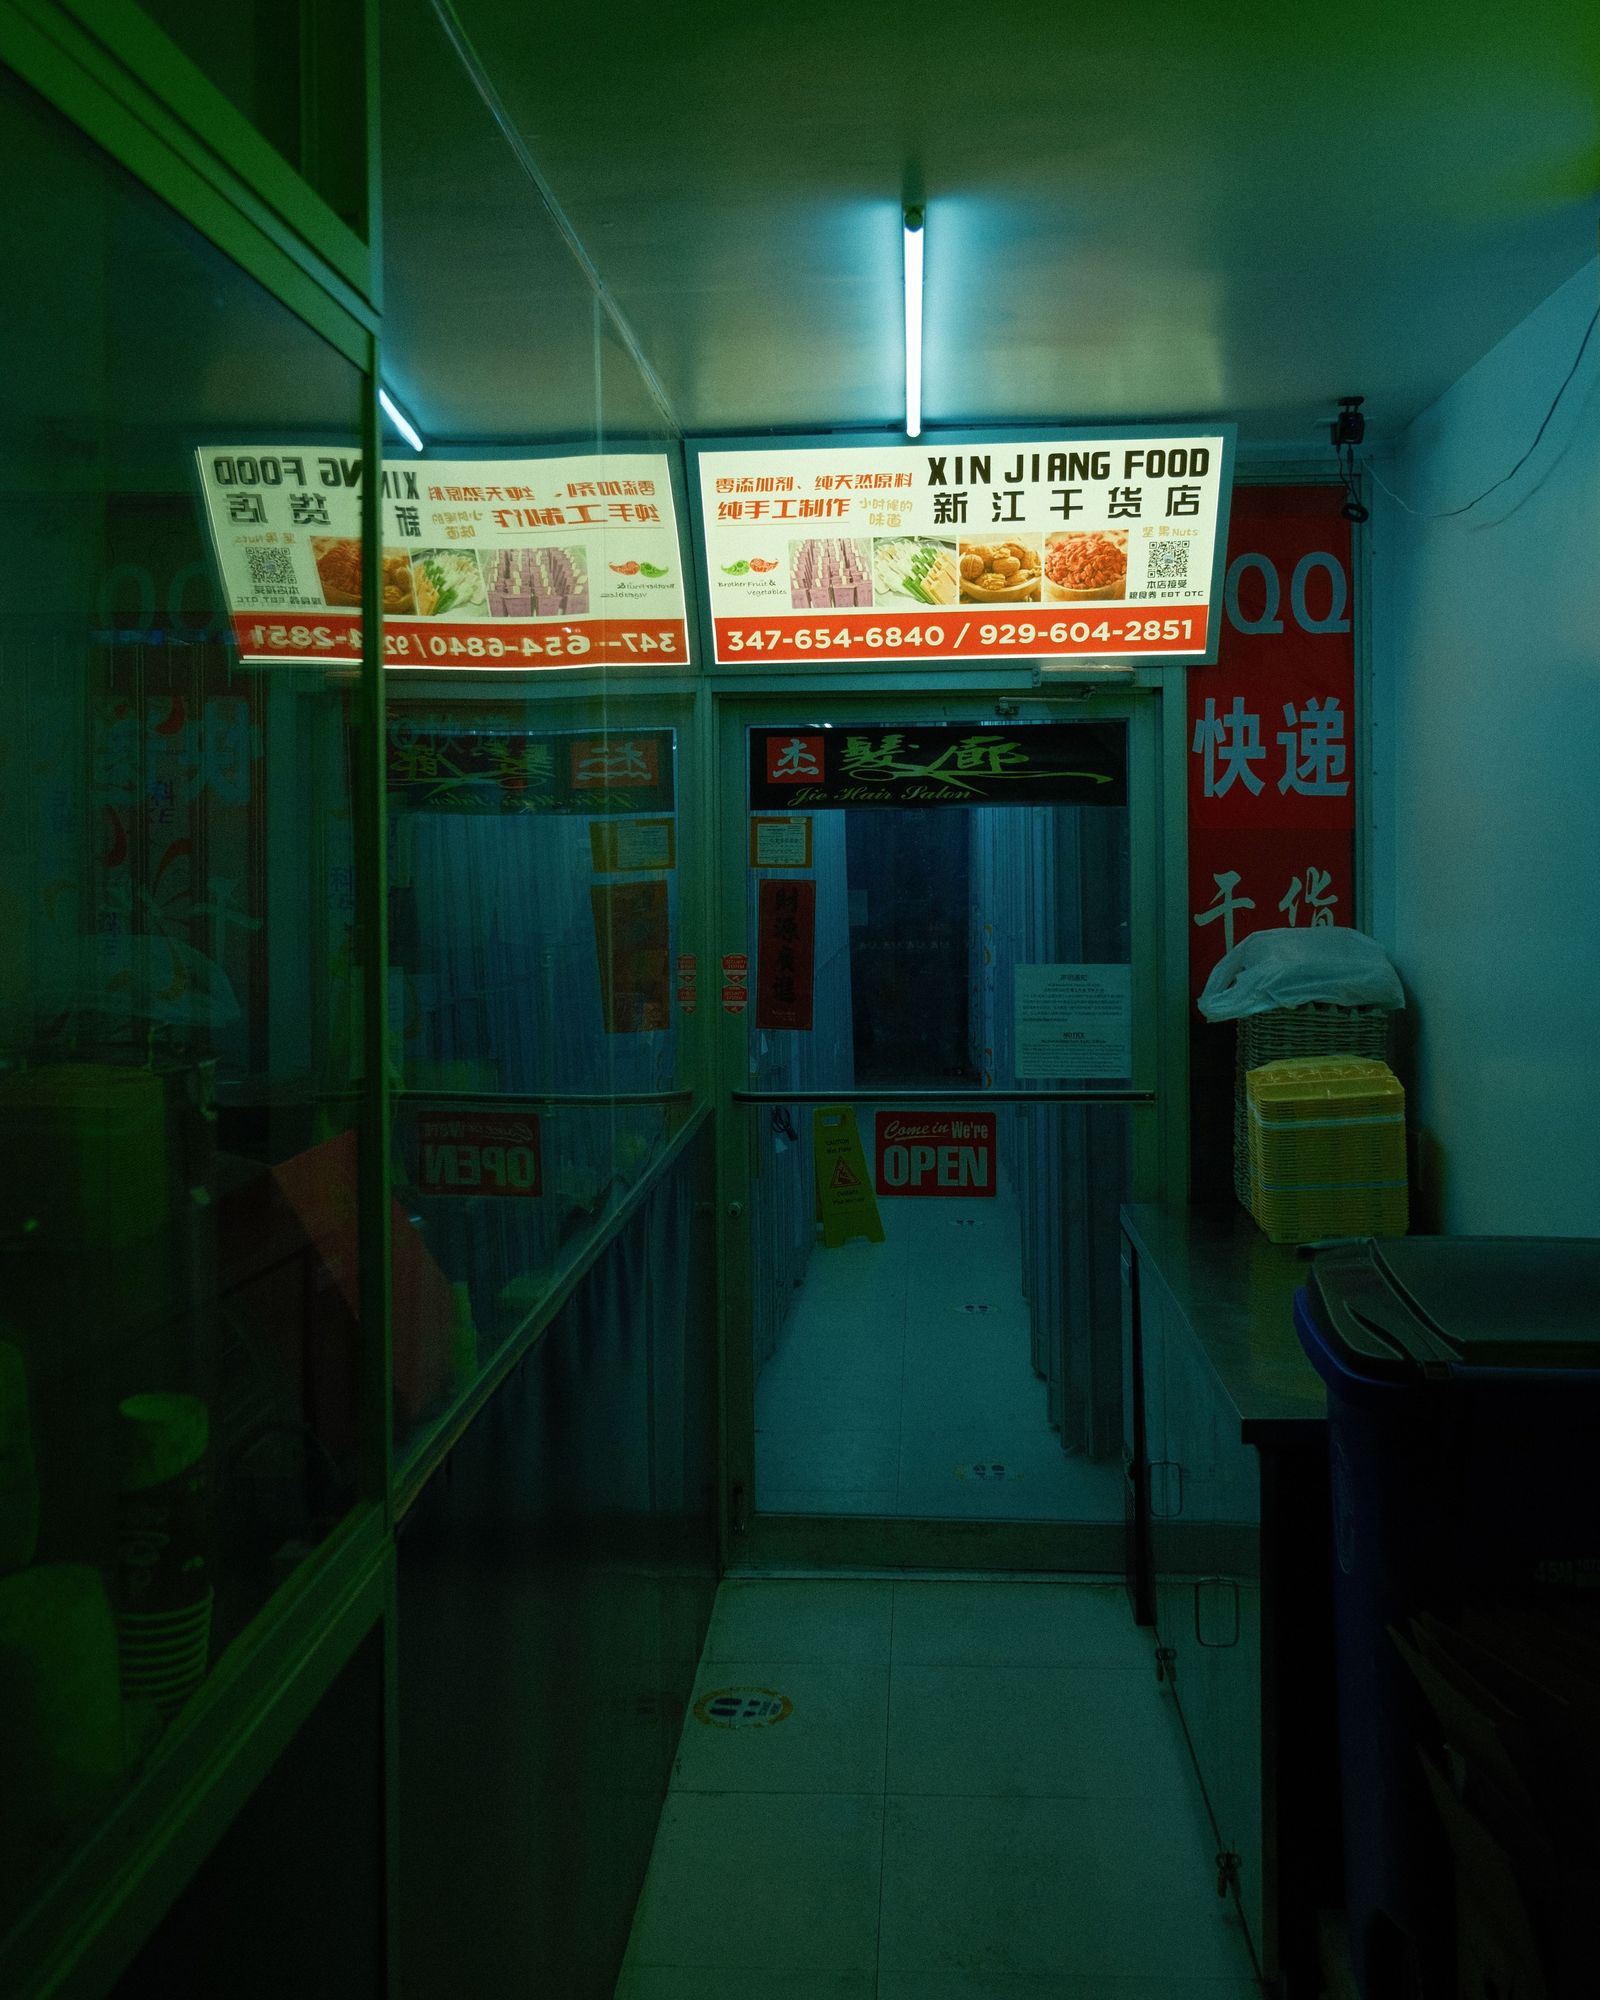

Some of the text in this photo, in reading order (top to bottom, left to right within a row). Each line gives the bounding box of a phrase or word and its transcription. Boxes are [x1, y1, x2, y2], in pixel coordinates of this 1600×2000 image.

[928, 448, 1210, 486] XIN JIANG FOOD
[717, 499, 850, 520] 纯手工制作
[934, 485, 1201, 524] 新江干货店
[1224, 551, 1351, 635] QQ
[727, 619, 1193, 651] 347-654-6840 / 929-604-2851
[772, 737, 820, 778] 杰
[1192, 696, 1351, 797] 快递
[787, 785, 972, 807] Jie Hair Salon
[883, 1120, 988, 1139] Come in We're
[883, 1145, 988, 1187] OPEN
